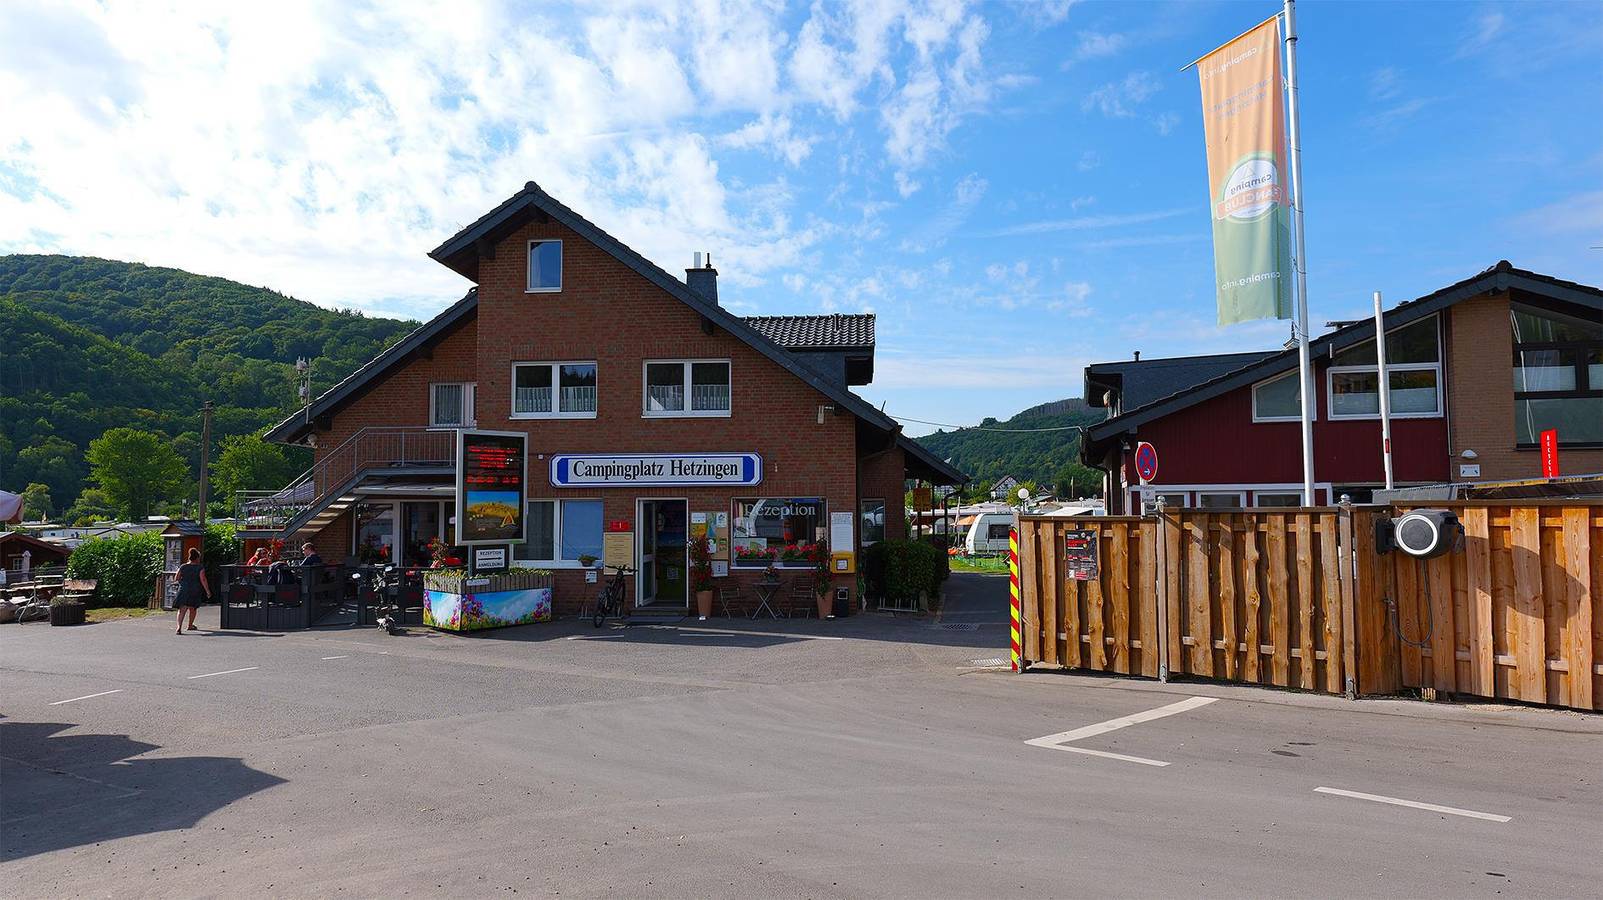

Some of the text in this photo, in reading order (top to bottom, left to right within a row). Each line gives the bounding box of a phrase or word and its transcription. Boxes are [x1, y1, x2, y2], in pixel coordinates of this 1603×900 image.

[573, 459, 738, 480] Campingplatz Hetzingen
[744, 503, 816, 519] Rezeption
